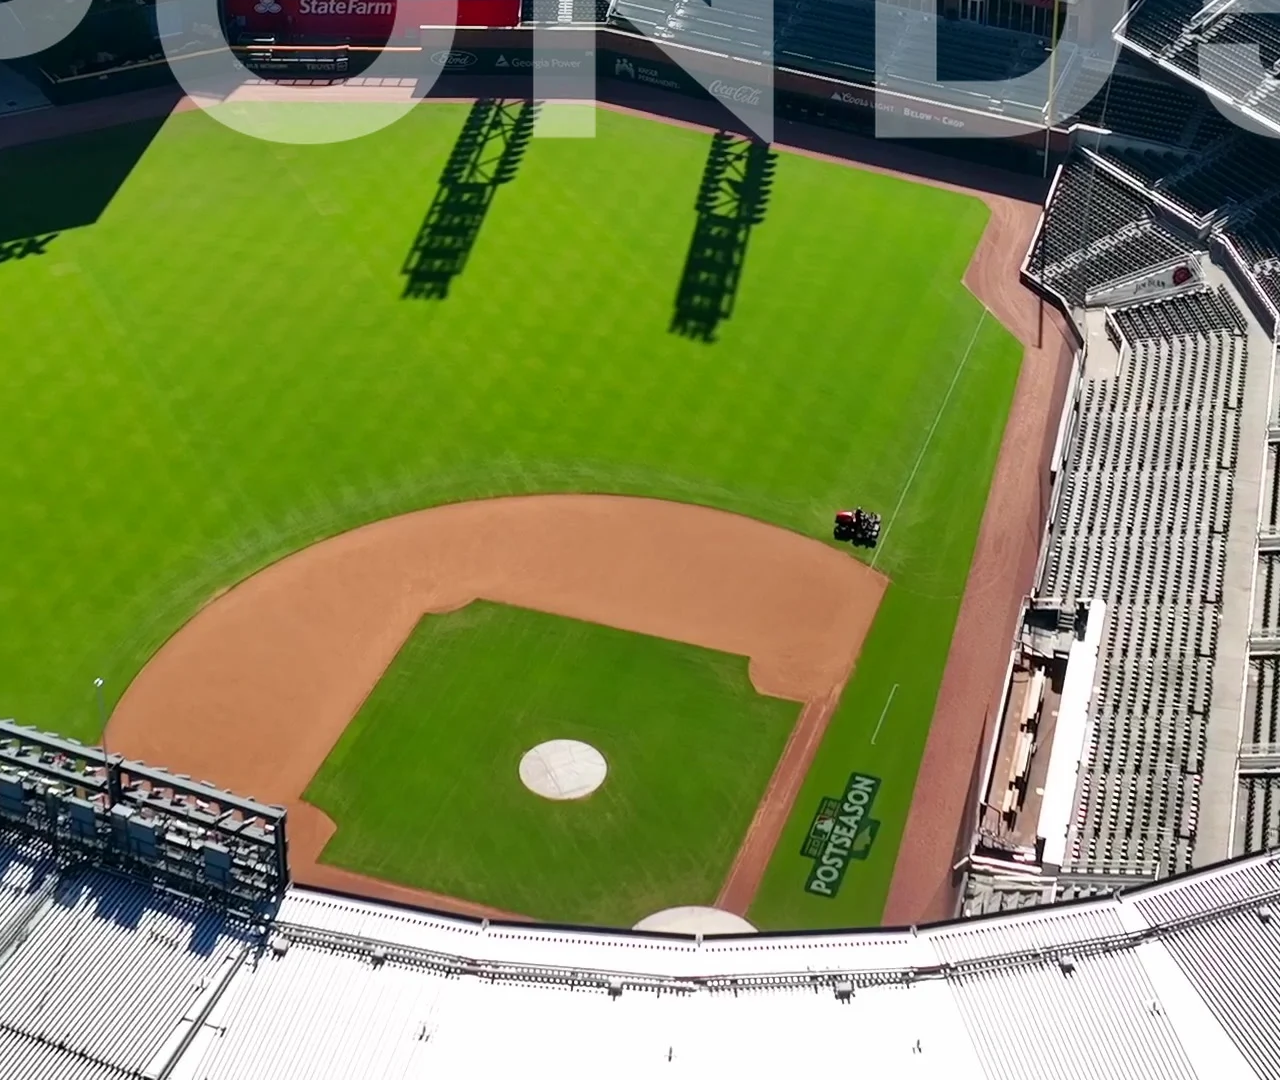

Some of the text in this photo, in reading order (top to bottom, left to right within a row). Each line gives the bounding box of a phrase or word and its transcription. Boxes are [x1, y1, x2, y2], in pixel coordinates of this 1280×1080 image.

[511, 56, 582, 70] Georgia Power
[810, 775, 876, 895] POSTSEASON
